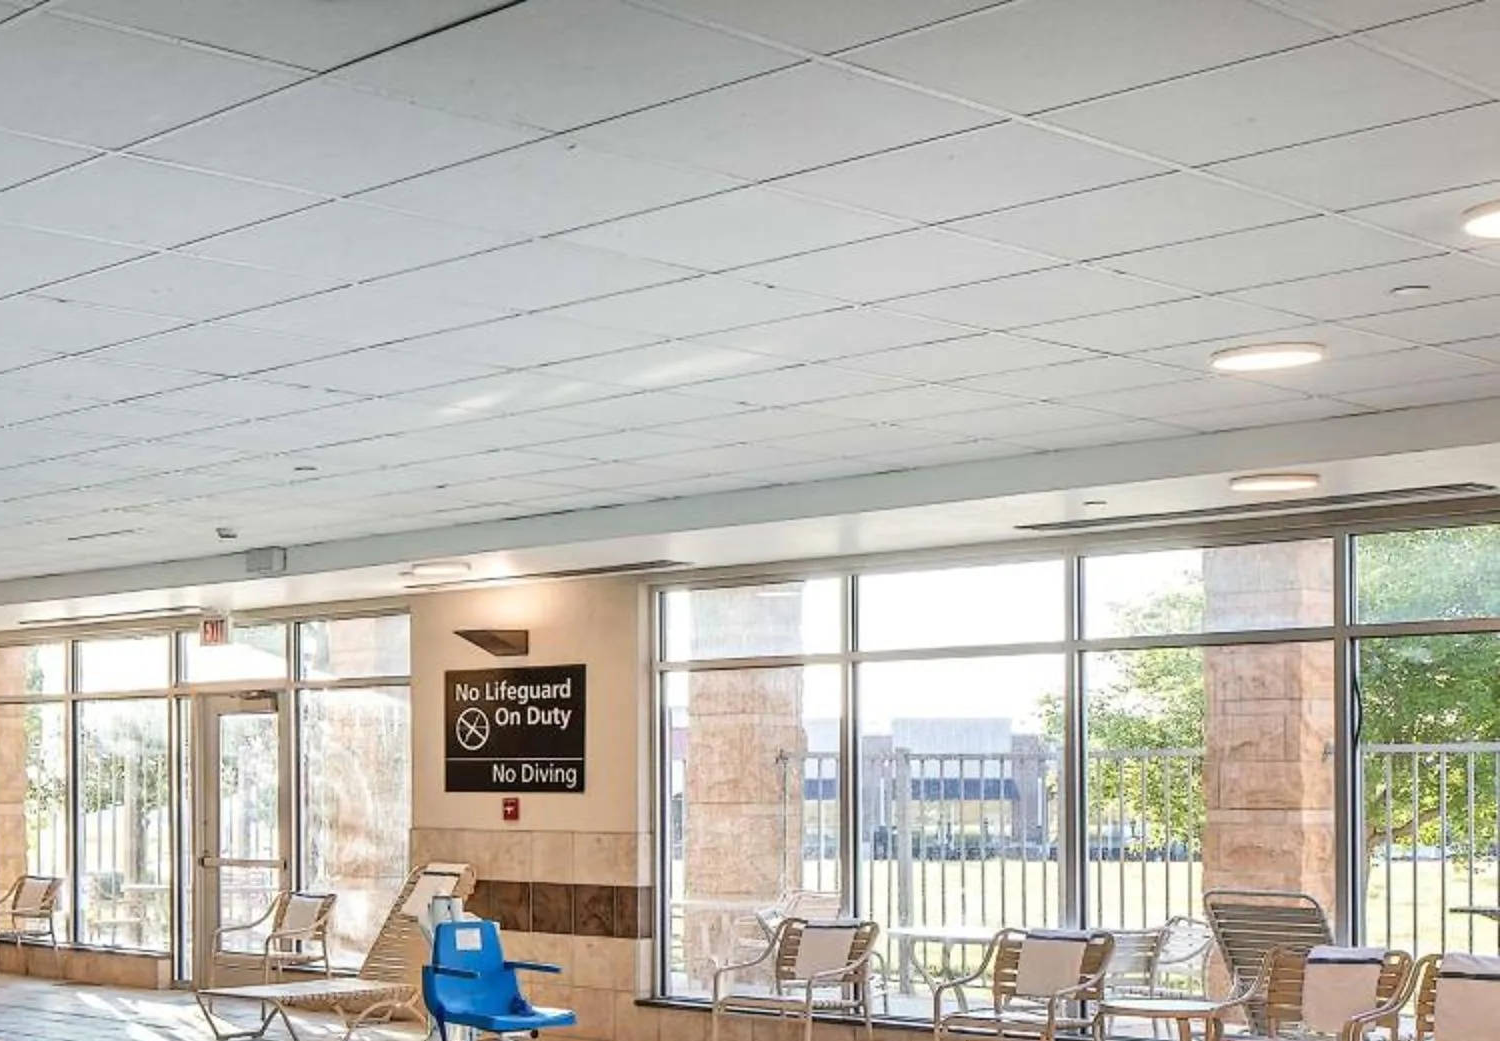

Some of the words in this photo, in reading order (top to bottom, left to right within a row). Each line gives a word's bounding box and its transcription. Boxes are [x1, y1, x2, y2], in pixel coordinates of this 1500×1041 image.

[203, 620, 225, 642] EXIT
[455, 683, 480, 701] No
[485, 678, 572, 705] Lifeguard
[495, 707, 521, 726] On
[527, 706, 572, 731] Duty
[492, 763, 517, 783] No
[521, 763, 577, 789] Diving
